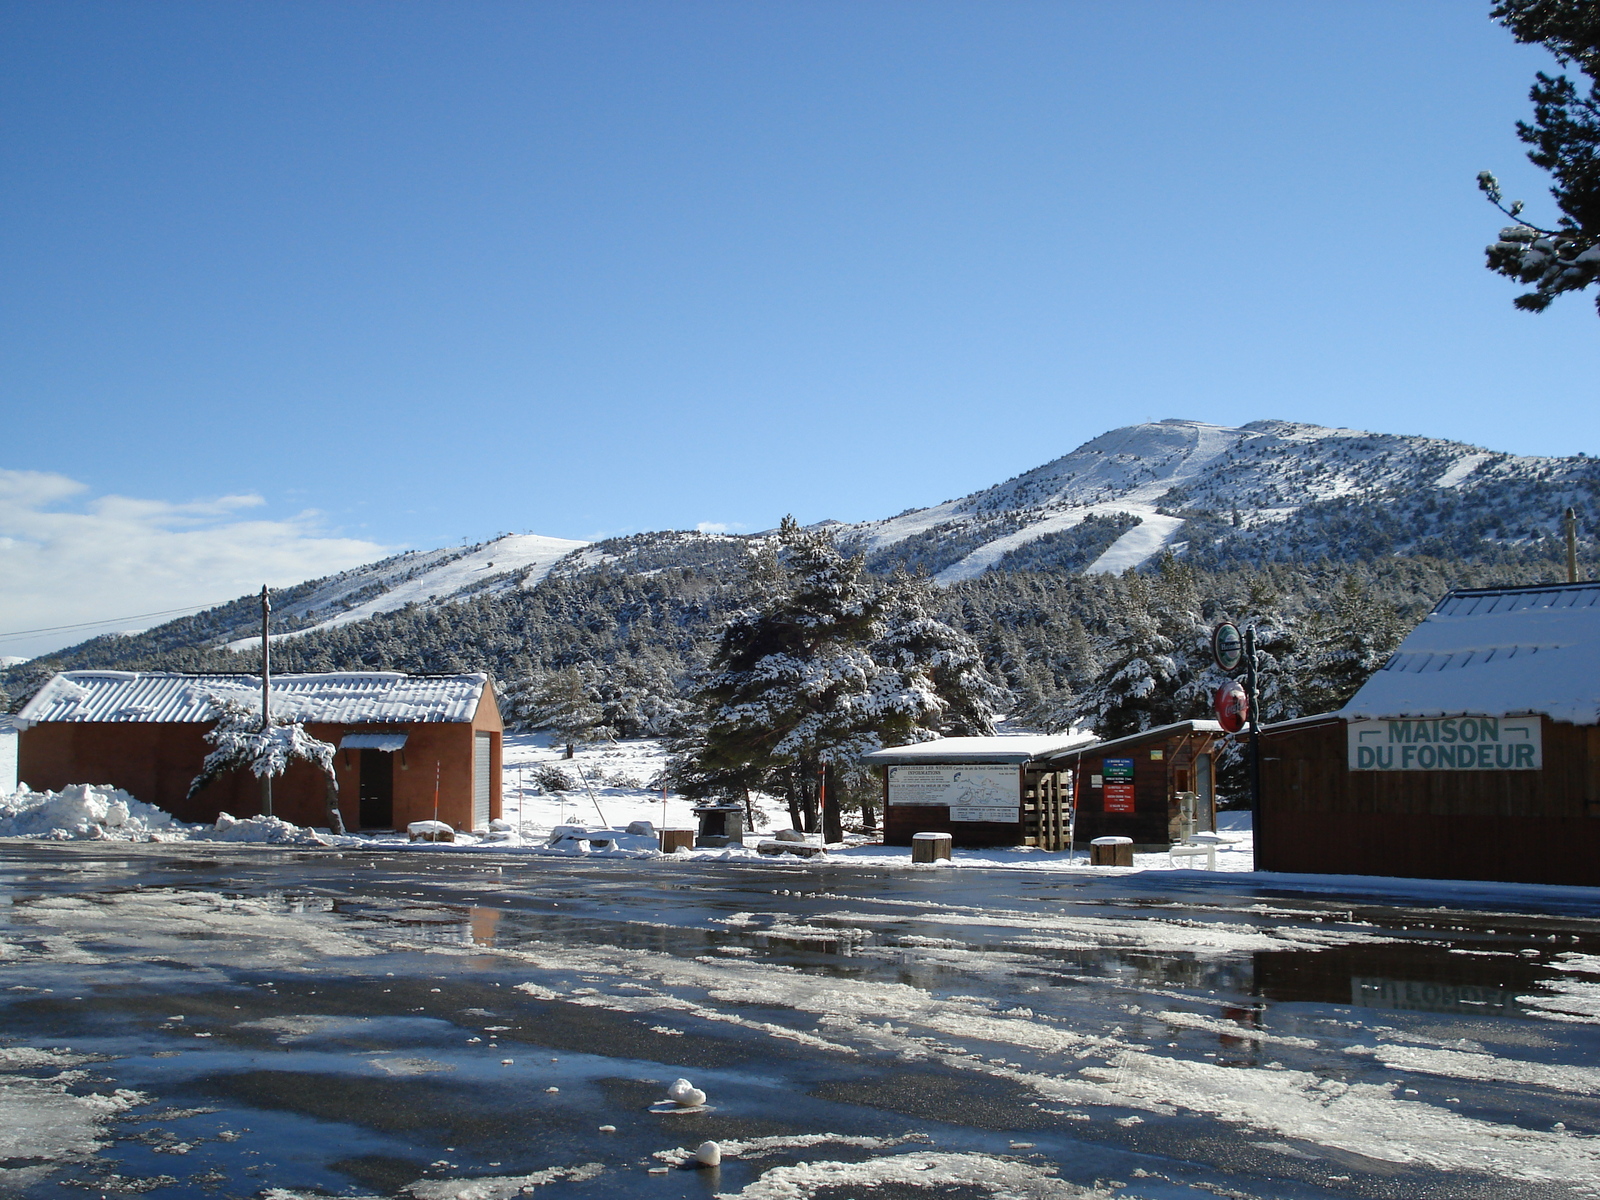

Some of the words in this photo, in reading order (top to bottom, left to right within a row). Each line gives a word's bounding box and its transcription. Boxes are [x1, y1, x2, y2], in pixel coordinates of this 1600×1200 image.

[1388, 719, 1499, 743] MAISON
[1358, 746, 1393, 769] DU
[1402, 744, 1535, 768] FONDEUR
